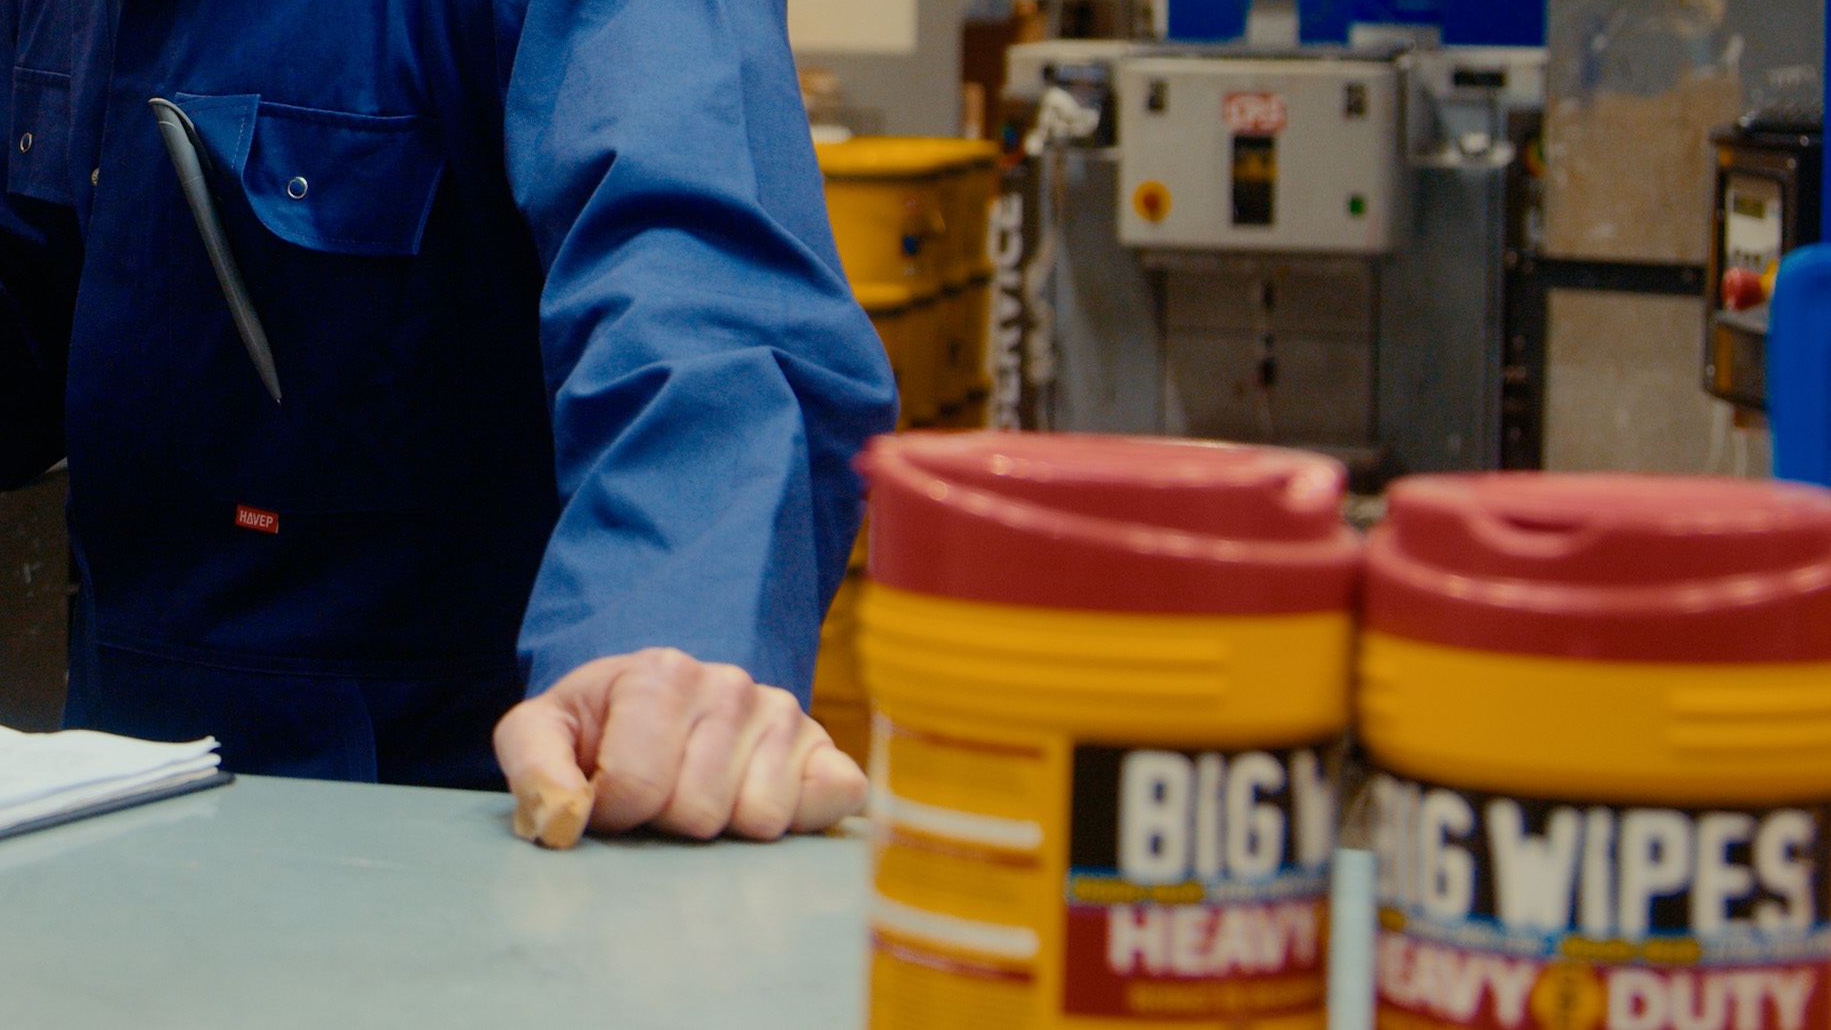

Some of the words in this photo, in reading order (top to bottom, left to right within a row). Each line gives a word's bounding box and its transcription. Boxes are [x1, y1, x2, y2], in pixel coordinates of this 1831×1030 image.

[240, 510, 274, 528] HAVEP
[1117, 749, 1286, 885] BIG
[1487, 799, 1816, 940] WIPES
[1606, 969, 1813, 1030] DUTY
